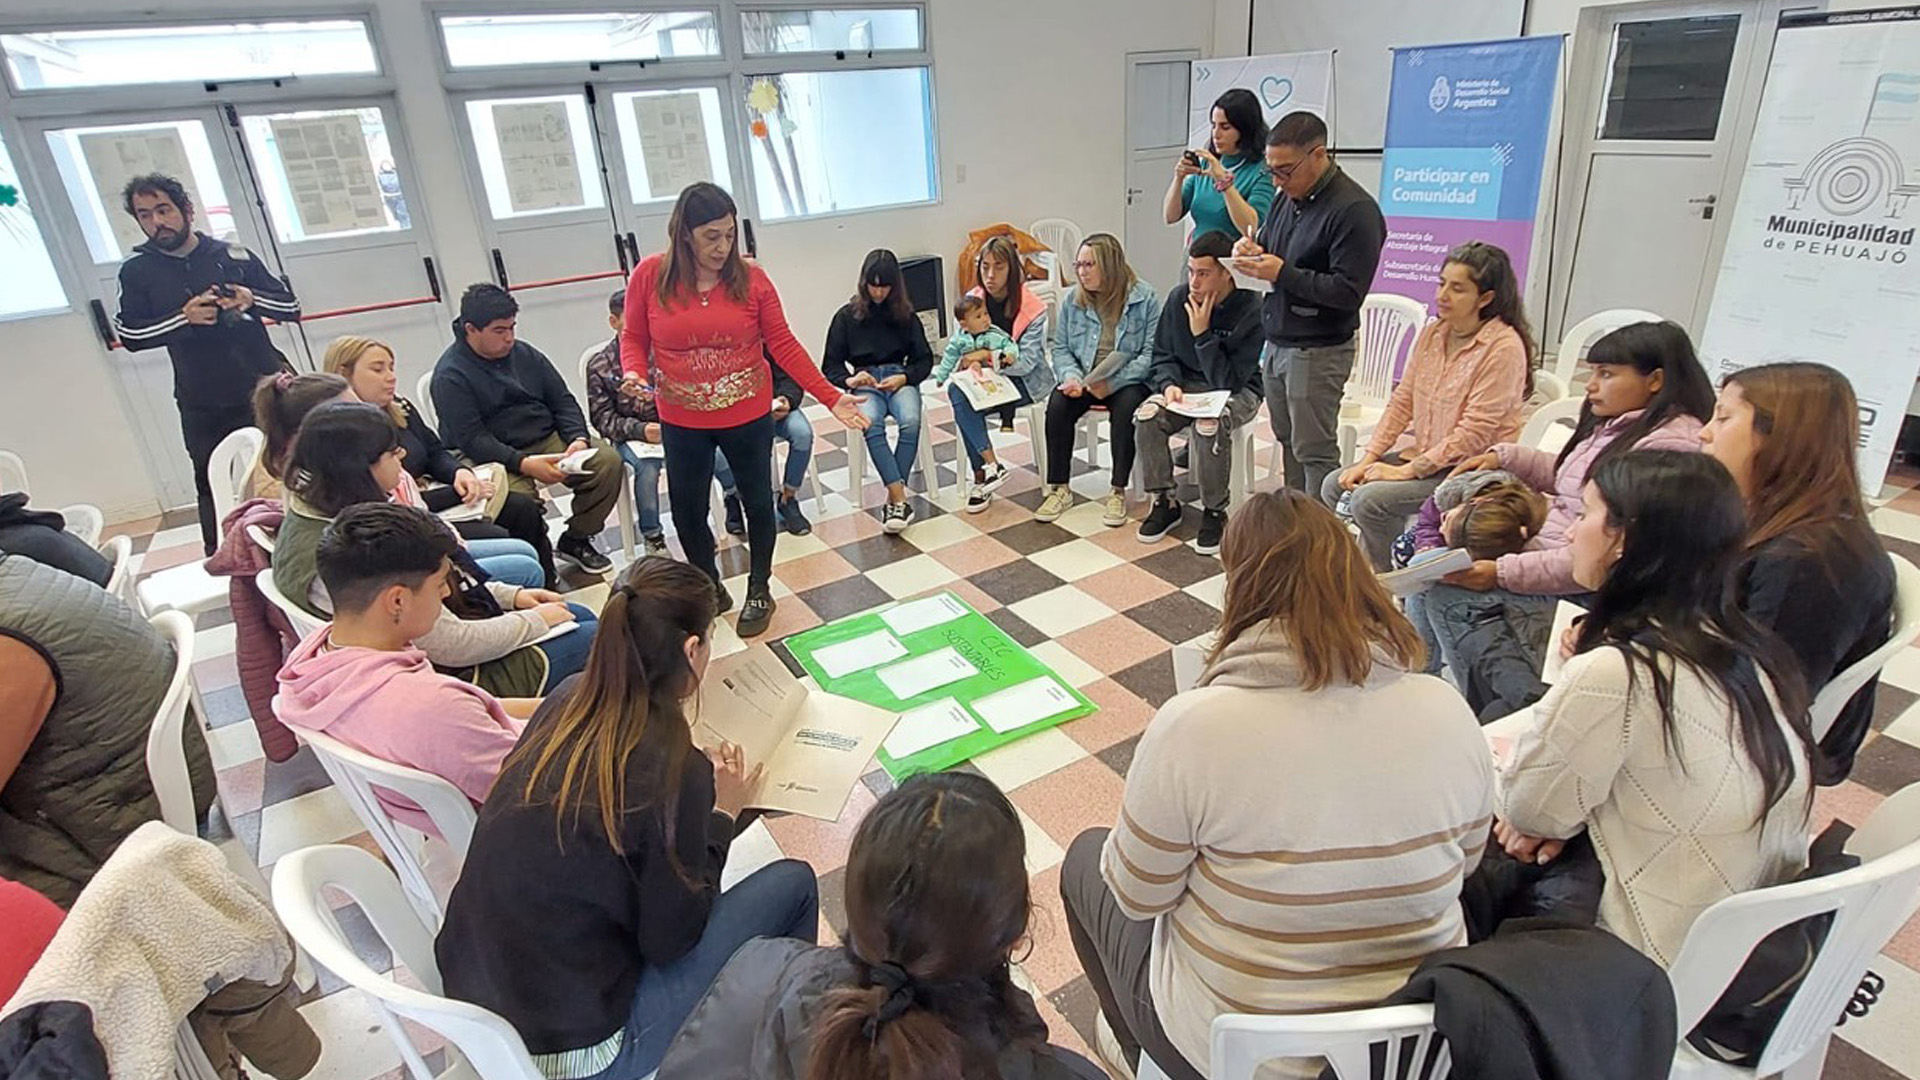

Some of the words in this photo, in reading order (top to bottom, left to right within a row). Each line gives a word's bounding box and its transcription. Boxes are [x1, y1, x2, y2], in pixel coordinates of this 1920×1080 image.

[1455, 79, 1489, 88] Ministerio
[1455, 88, 1489, 97] Desarrollo
[1489, 86, 1510, 96] Social
[1453, 98, 1498, 110] Argentina
[1393, 167, 1468, 187] Participar
[1469, 171, 1491, 184] en
[1392, 186, 1477, 205] Comunidad
[1766, 215, 1916, 246] Municipalidad
[1419, 243, 1449, 255] Integral
[1763, 237, 1786, 250] de
[1793, 240, 1908, 265] PEHUAJÓ
[980, 635, 1014, 658] CIC
